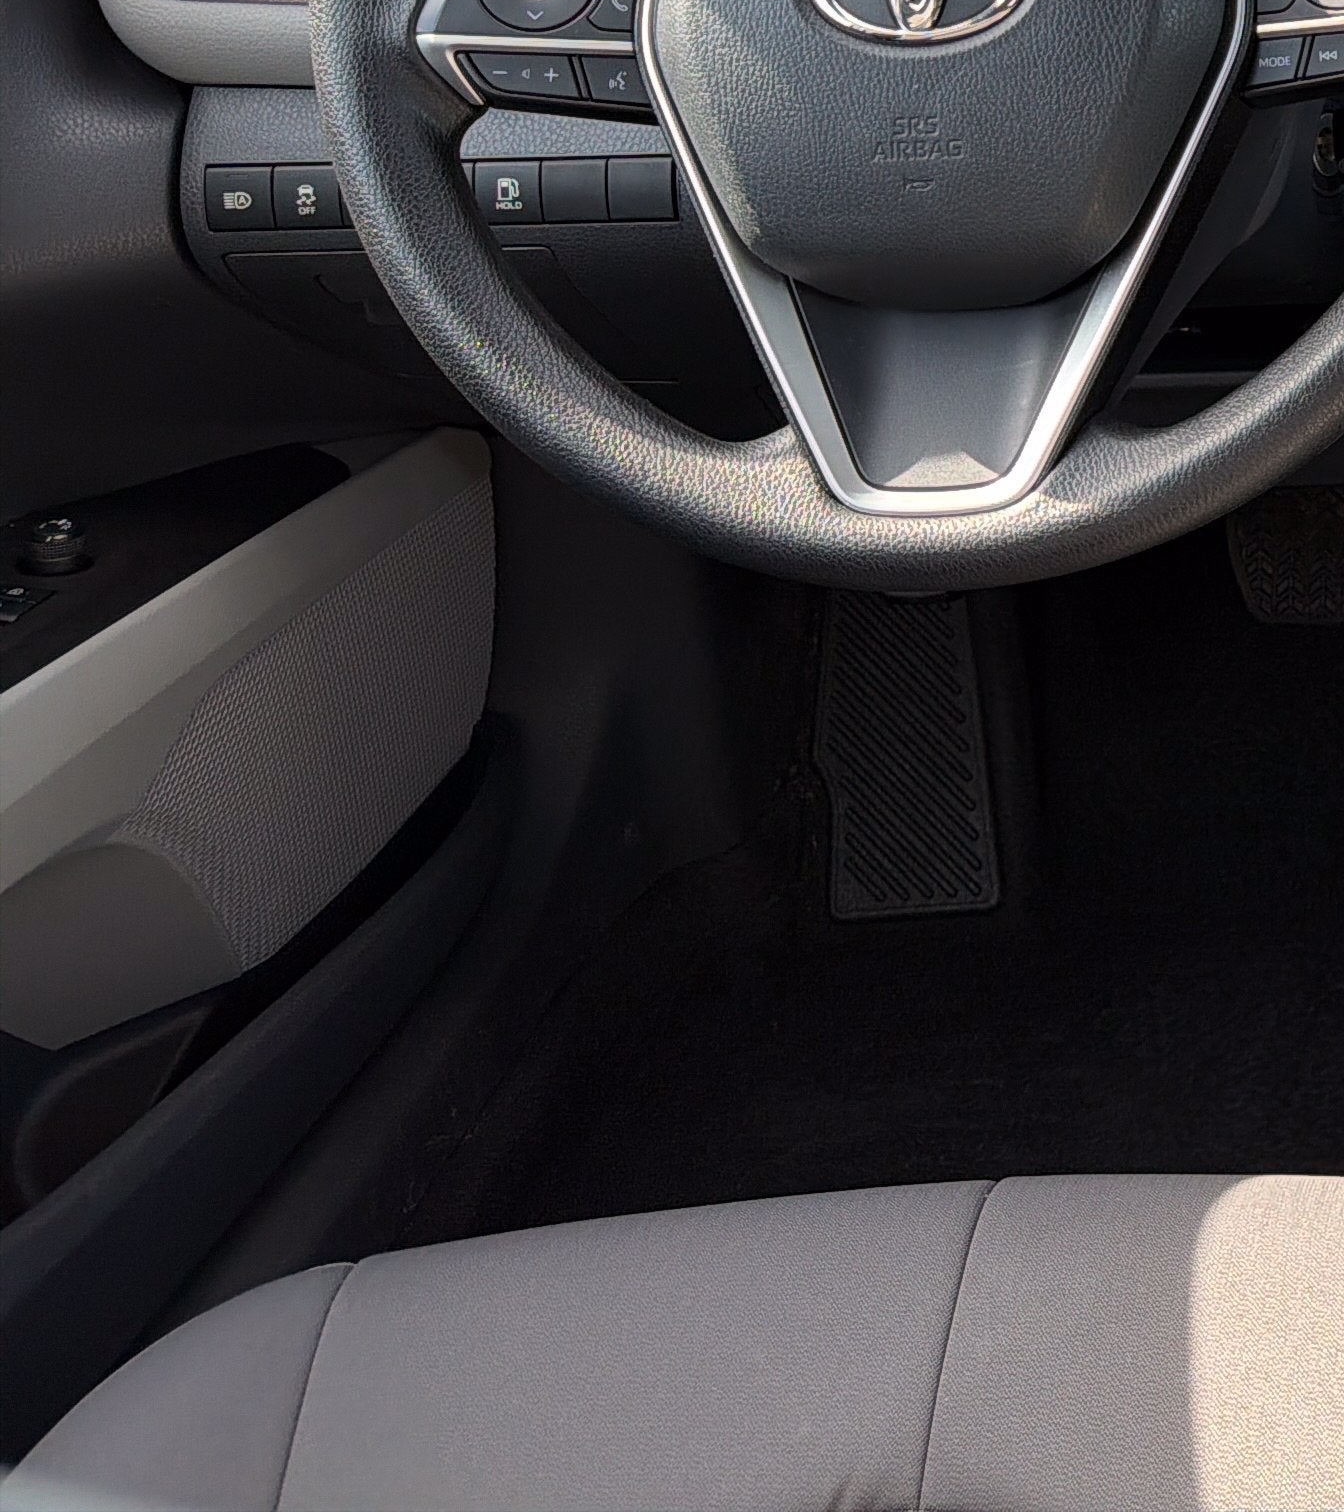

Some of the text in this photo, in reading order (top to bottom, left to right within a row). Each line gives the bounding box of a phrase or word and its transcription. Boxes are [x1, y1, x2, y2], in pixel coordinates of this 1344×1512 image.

[1259, 56, 1291, 68] MODE
[893, 116, 940, 138] SRS
[872, 139, 964, 163] AIRBAG
[297, 206, 316, 215] OFF
[495, 201, 522, 210] HOLD
